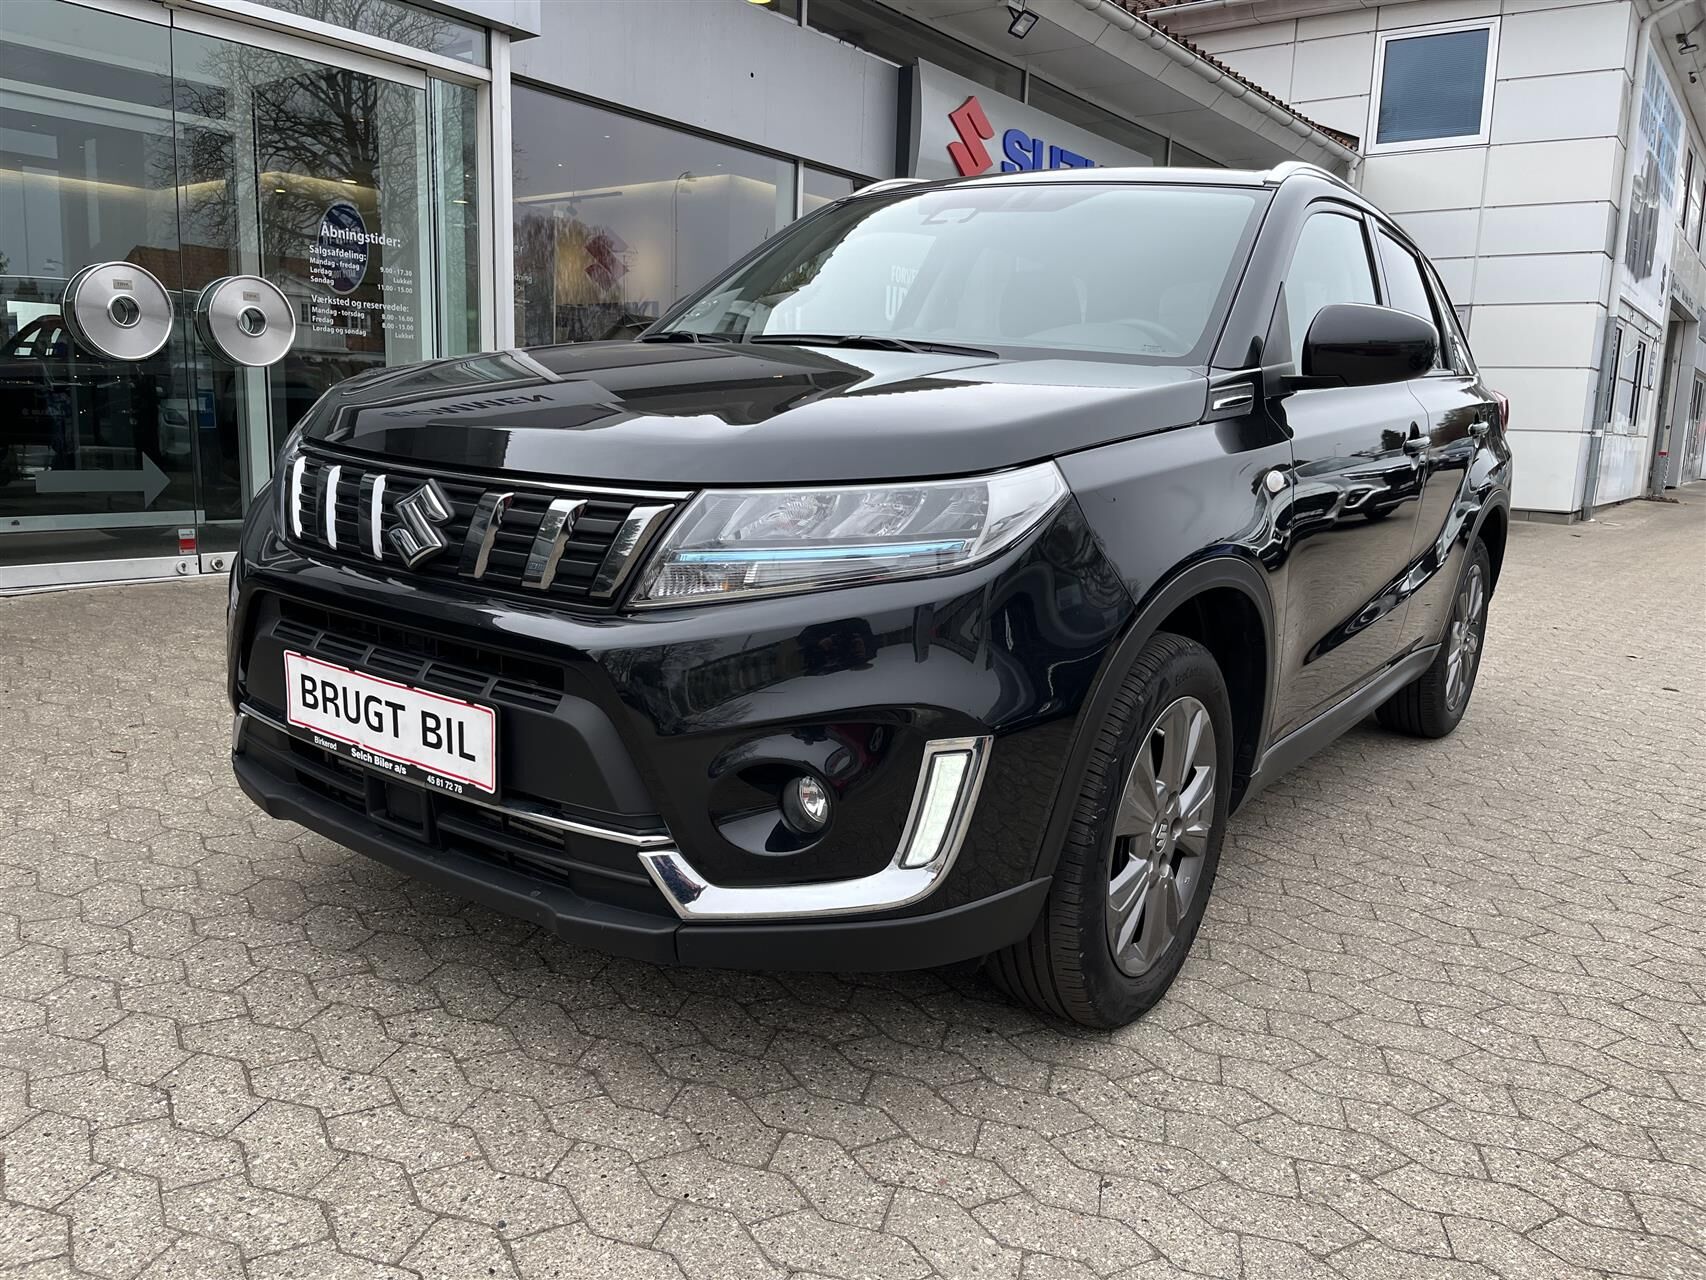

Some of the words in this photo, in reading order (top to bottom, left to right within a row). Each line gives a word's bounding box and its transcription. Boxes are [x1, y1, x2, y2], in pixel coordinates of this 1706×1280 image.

[321, 221, 401, 248] Åbningstider:
[309, 244, 367, 262] Salgsafdeling:
[309, 257, 335, 268] Mandag
[340, 260, 360, 271] fredag
[380, 266, 393, 274] 9.00
[393, 277, 413, 285] Lukket
[377, 284, 394, 292] 11.00
[311, 294, 350, 307] Værksted
[351, 301, 362, 310] og
[363, 302, 409, 313] reservedele:
[311, 306, 338, 316] Mandag
[341, 310, 365, 319] torsdag
[381, 313, 394, 321] 8.00
[312, 316, 334, 325] Fredag
[395, 332, 414, 340] Lukket
[301, 673, 406, 739] BRUGT
[421, 710, 476, 762] BIL
[351, 747, 373, 764] Selch
[374, 756, 393, 770] Biler
[394, 765, 408, 775] a/s
[427, 775, 435, 784] 45
[436, 777, 444, 787] 81
[445, 780, 453, 791] 72
[454, 783, 463, 794] 78
